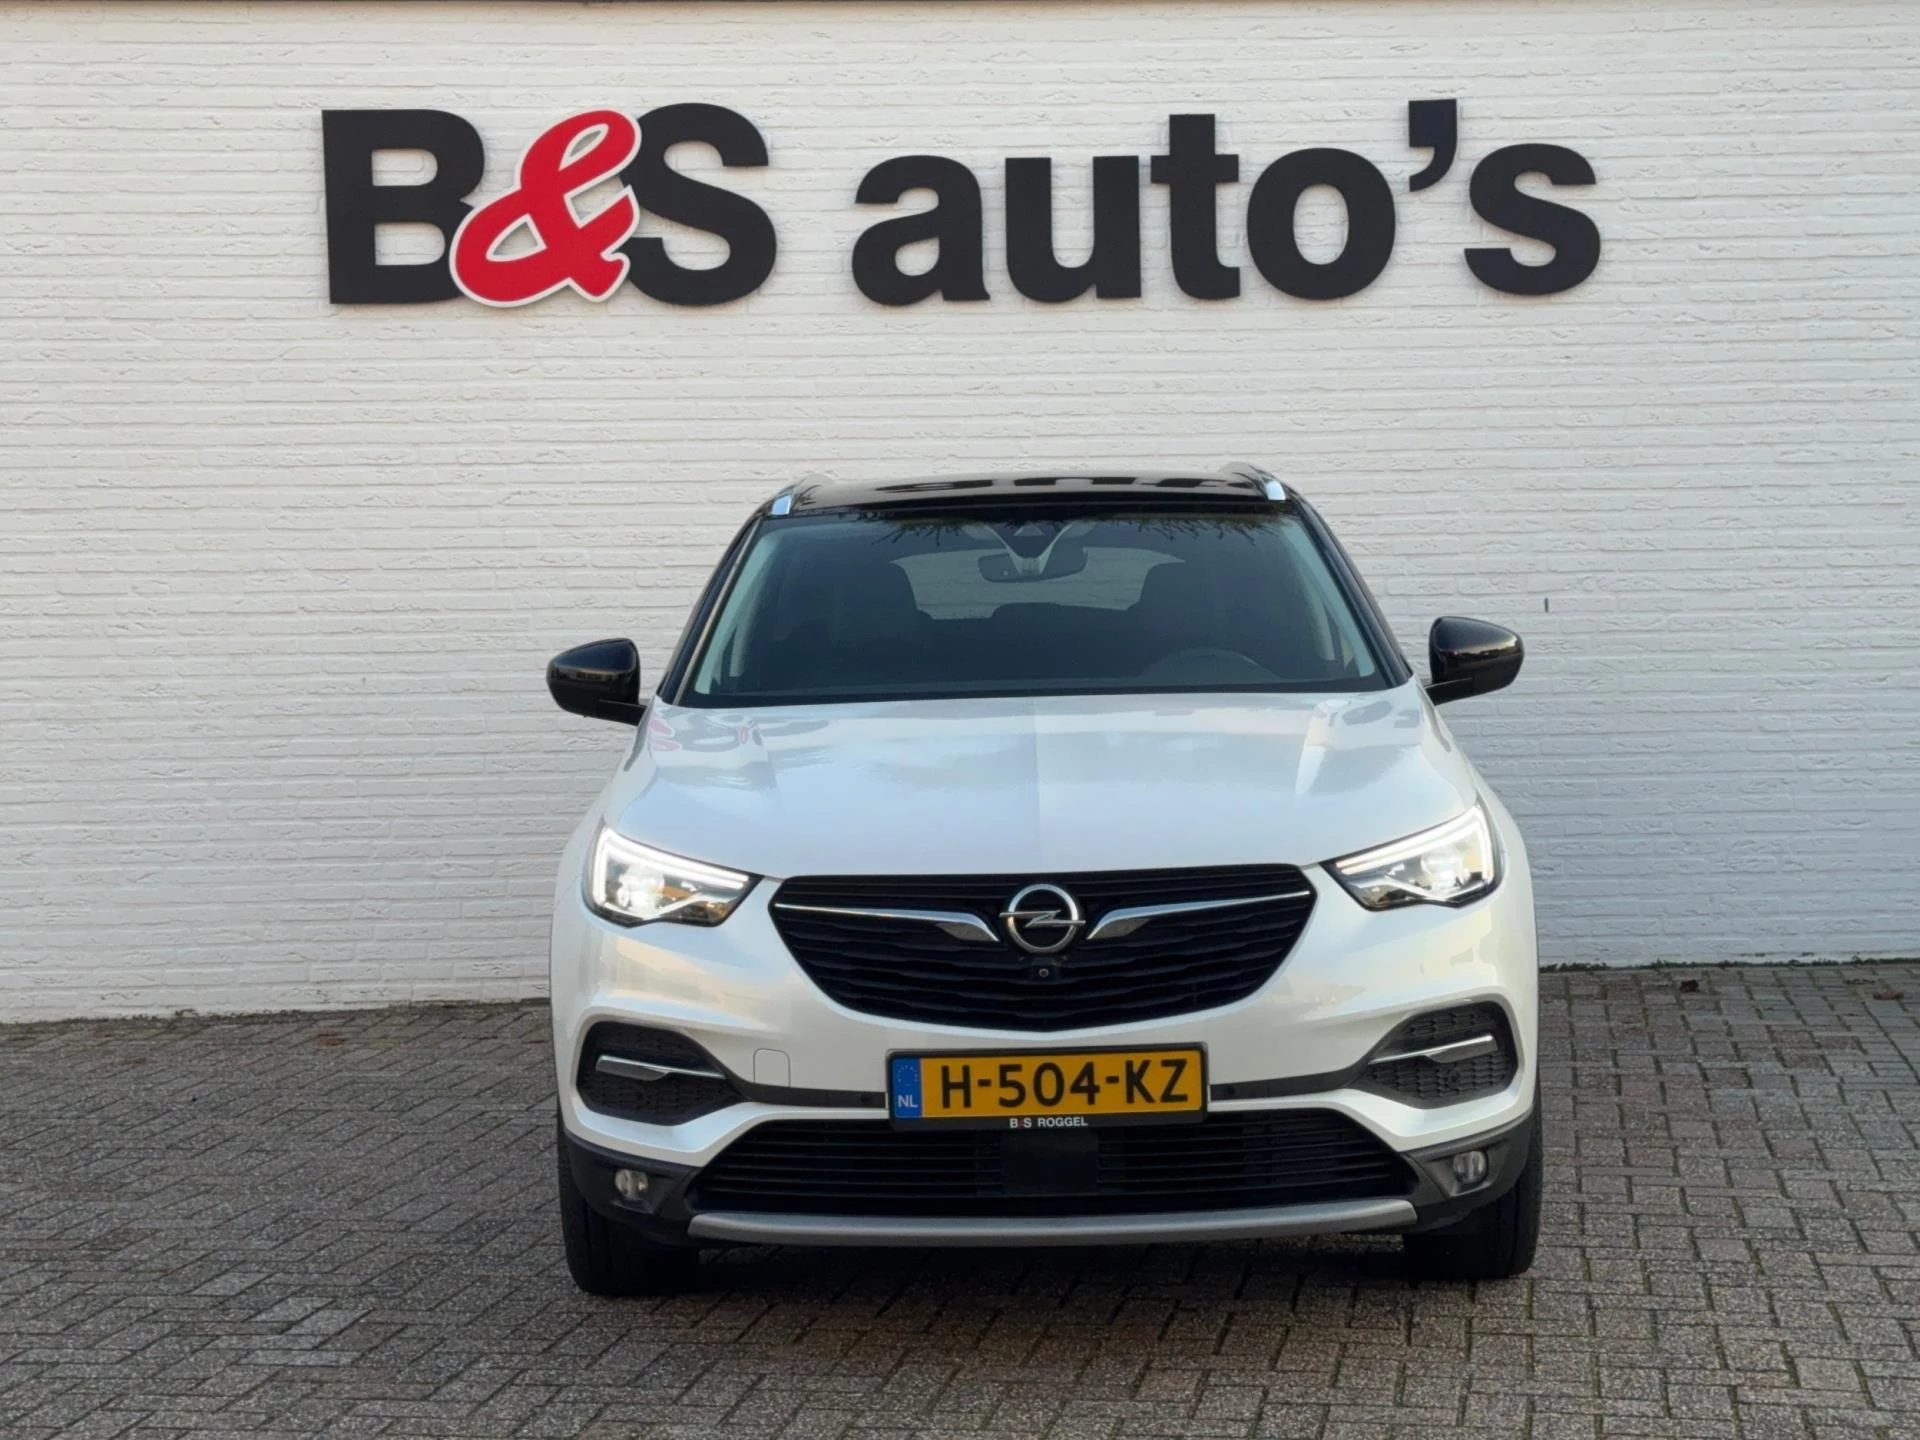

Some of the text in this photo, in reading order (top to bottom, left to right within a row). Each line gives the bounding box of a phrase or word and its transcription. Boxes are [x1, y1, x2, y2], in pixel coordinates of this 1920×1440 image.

[322, 98, 1600, 307] B&S auto's
[940, 1058, 1189, 1109] H-504-KZ
[897, 1093, 918, 1108] NL
[1037, 1116, 1088, 1128] ROGGEL
